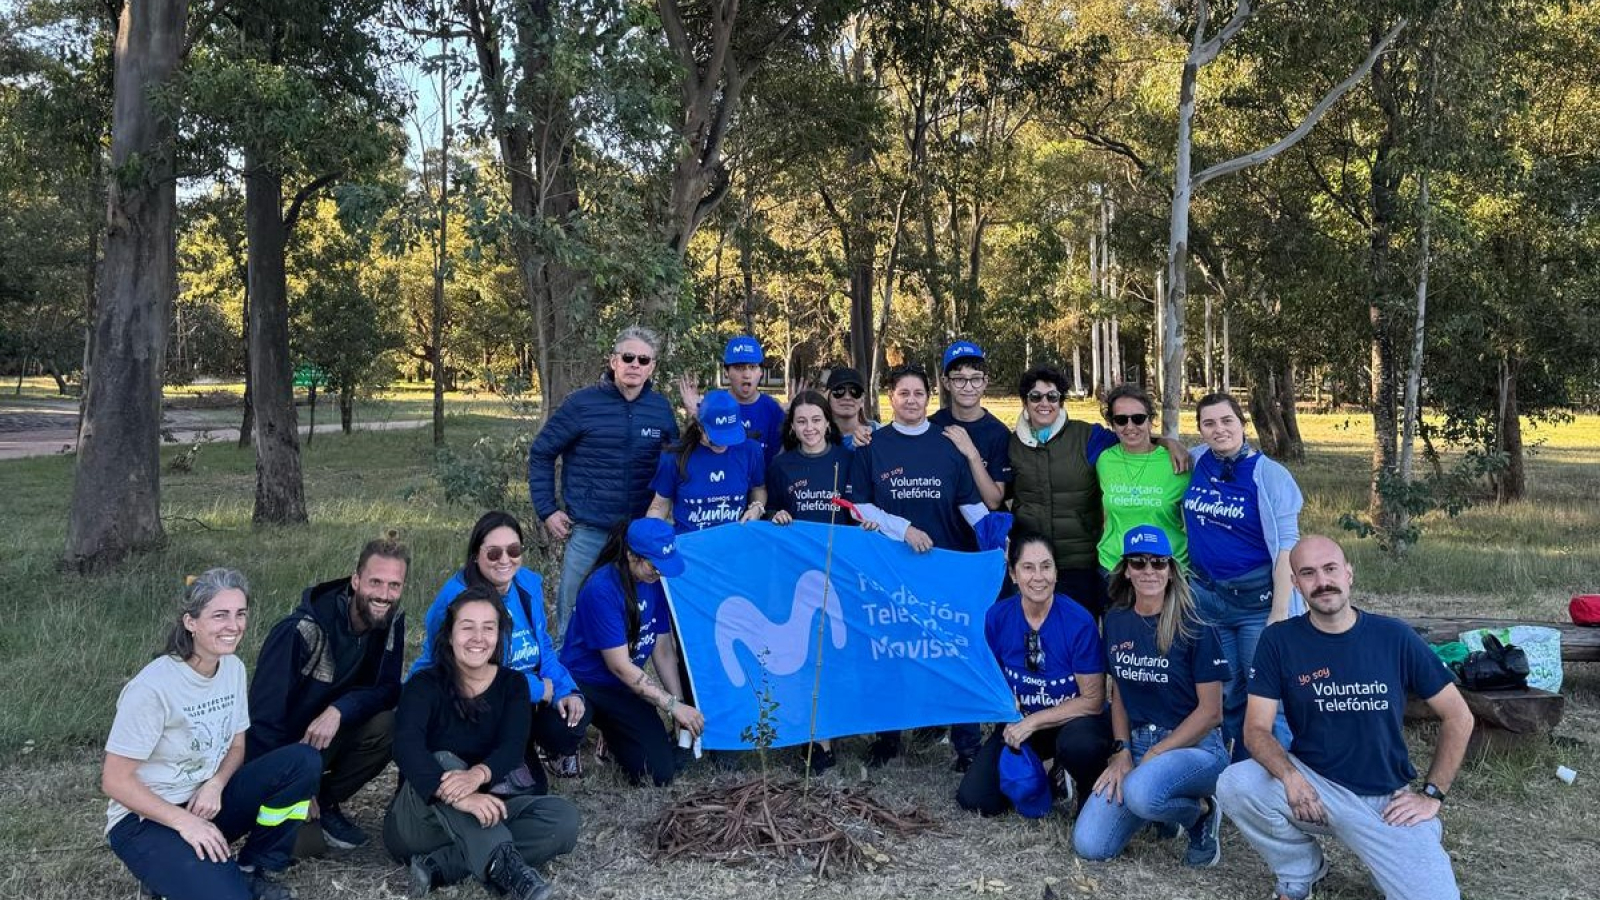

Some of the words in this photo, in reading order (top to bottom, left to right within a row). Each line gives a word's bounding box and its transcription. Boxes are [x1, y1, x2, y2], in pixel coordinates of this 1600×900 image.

[890, 476, 941, 487] Voluntario
[890, 487, 941, 500] Telefónica
[1312, 667, 1330, 680] soy
[1022, 675, 1048, 687] SOMOS
[1312, 680, 1389, 696] Voluntario
[1314, 697, 1389, 712] Telefónica
